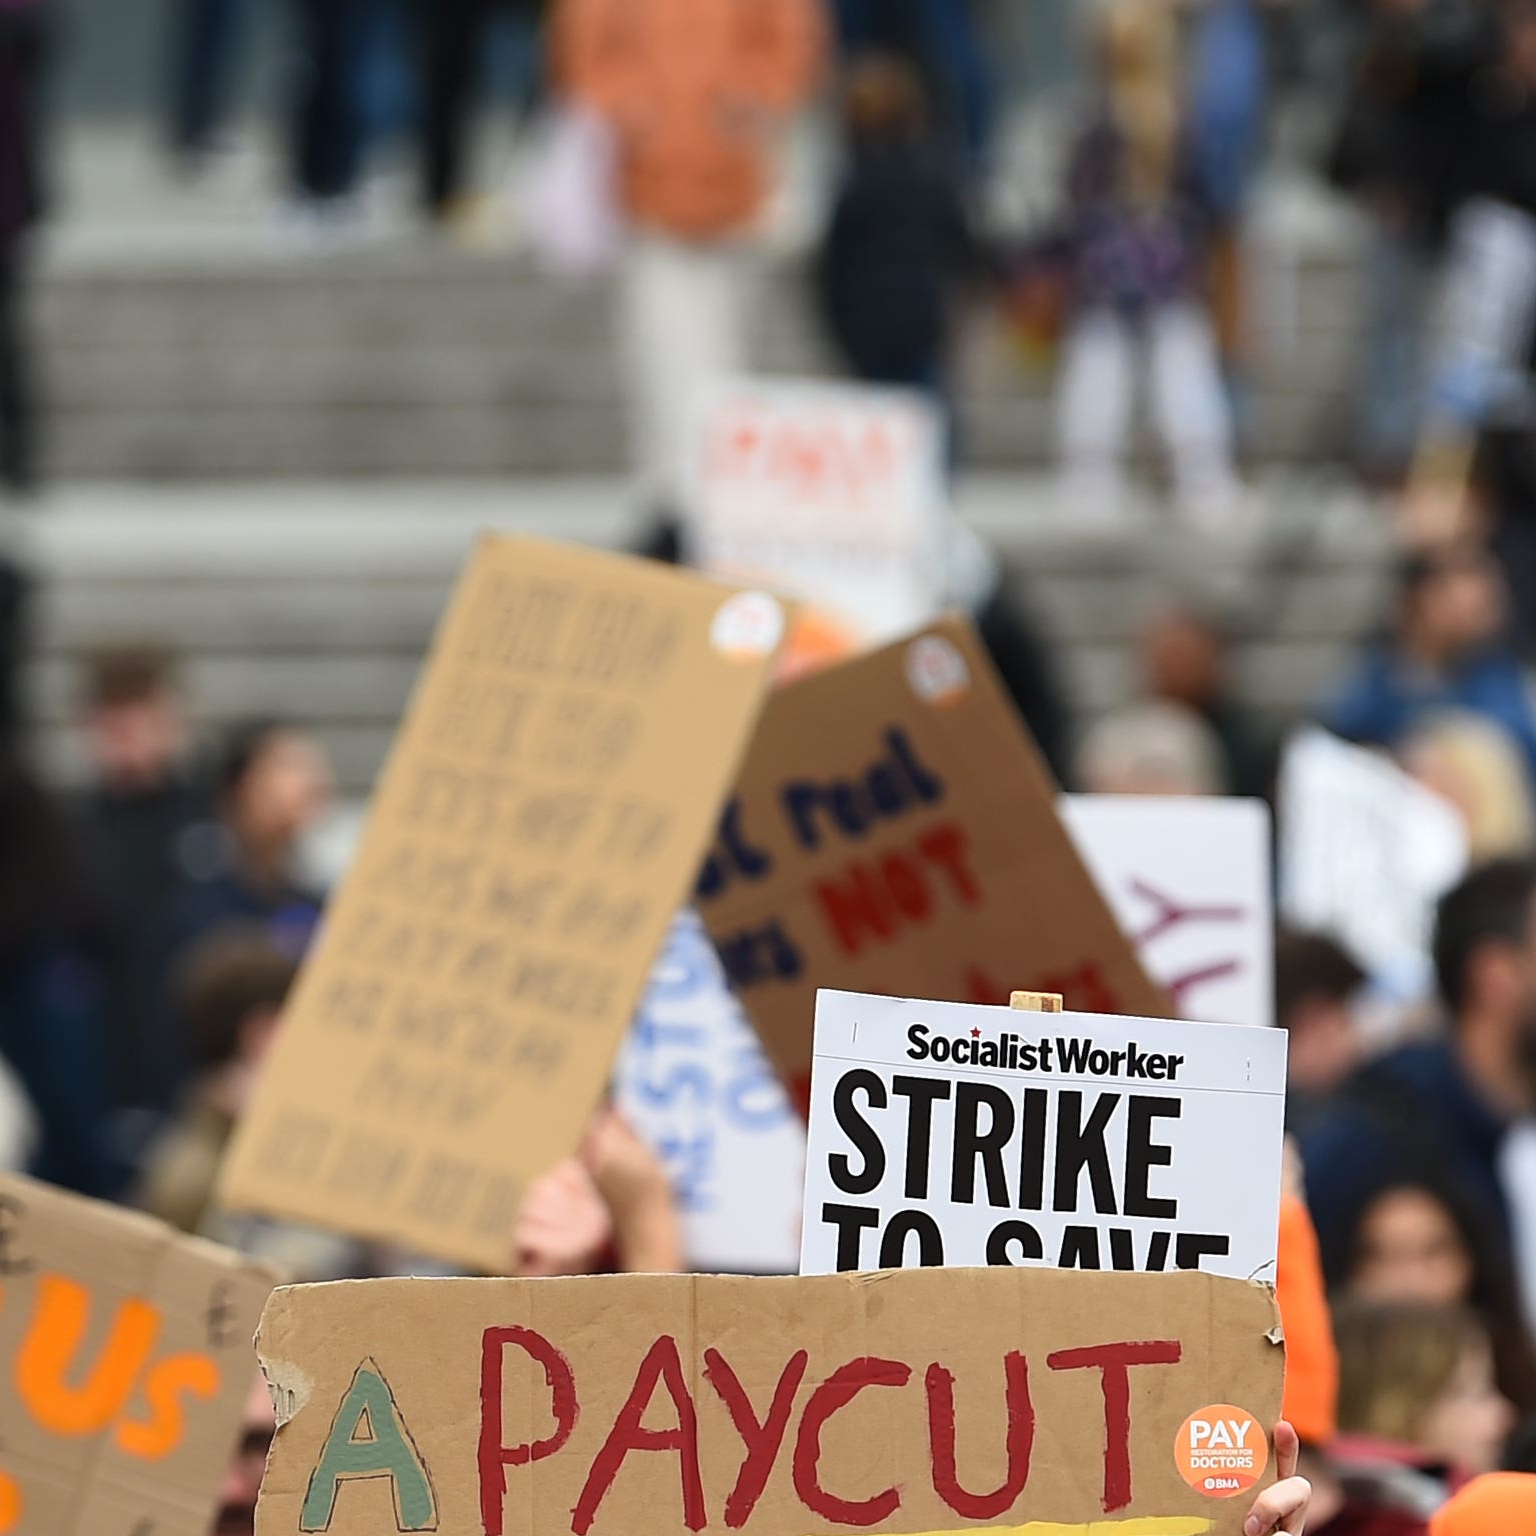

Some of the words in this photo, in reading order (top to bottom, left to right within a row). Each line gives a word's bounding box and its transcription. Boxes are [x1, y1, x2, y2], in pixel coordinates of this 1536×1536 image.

[810, 821, 981, 955] NOT
[906, 1022, 1053, 1074] Socialist
[1057, 1037, 1184, 1082] Worker
[827, 1068, 1183, 1220] STRIKE
[299, 1355, 438, 1534] A
[478, 1324, 1182, 1536] PAYCUT
[1189, 1419, 1252, 1449] PAY
[1191, 1457, 1253, 1469] DOCTORS
[1216, 1478, 1239, 1489] BMA
